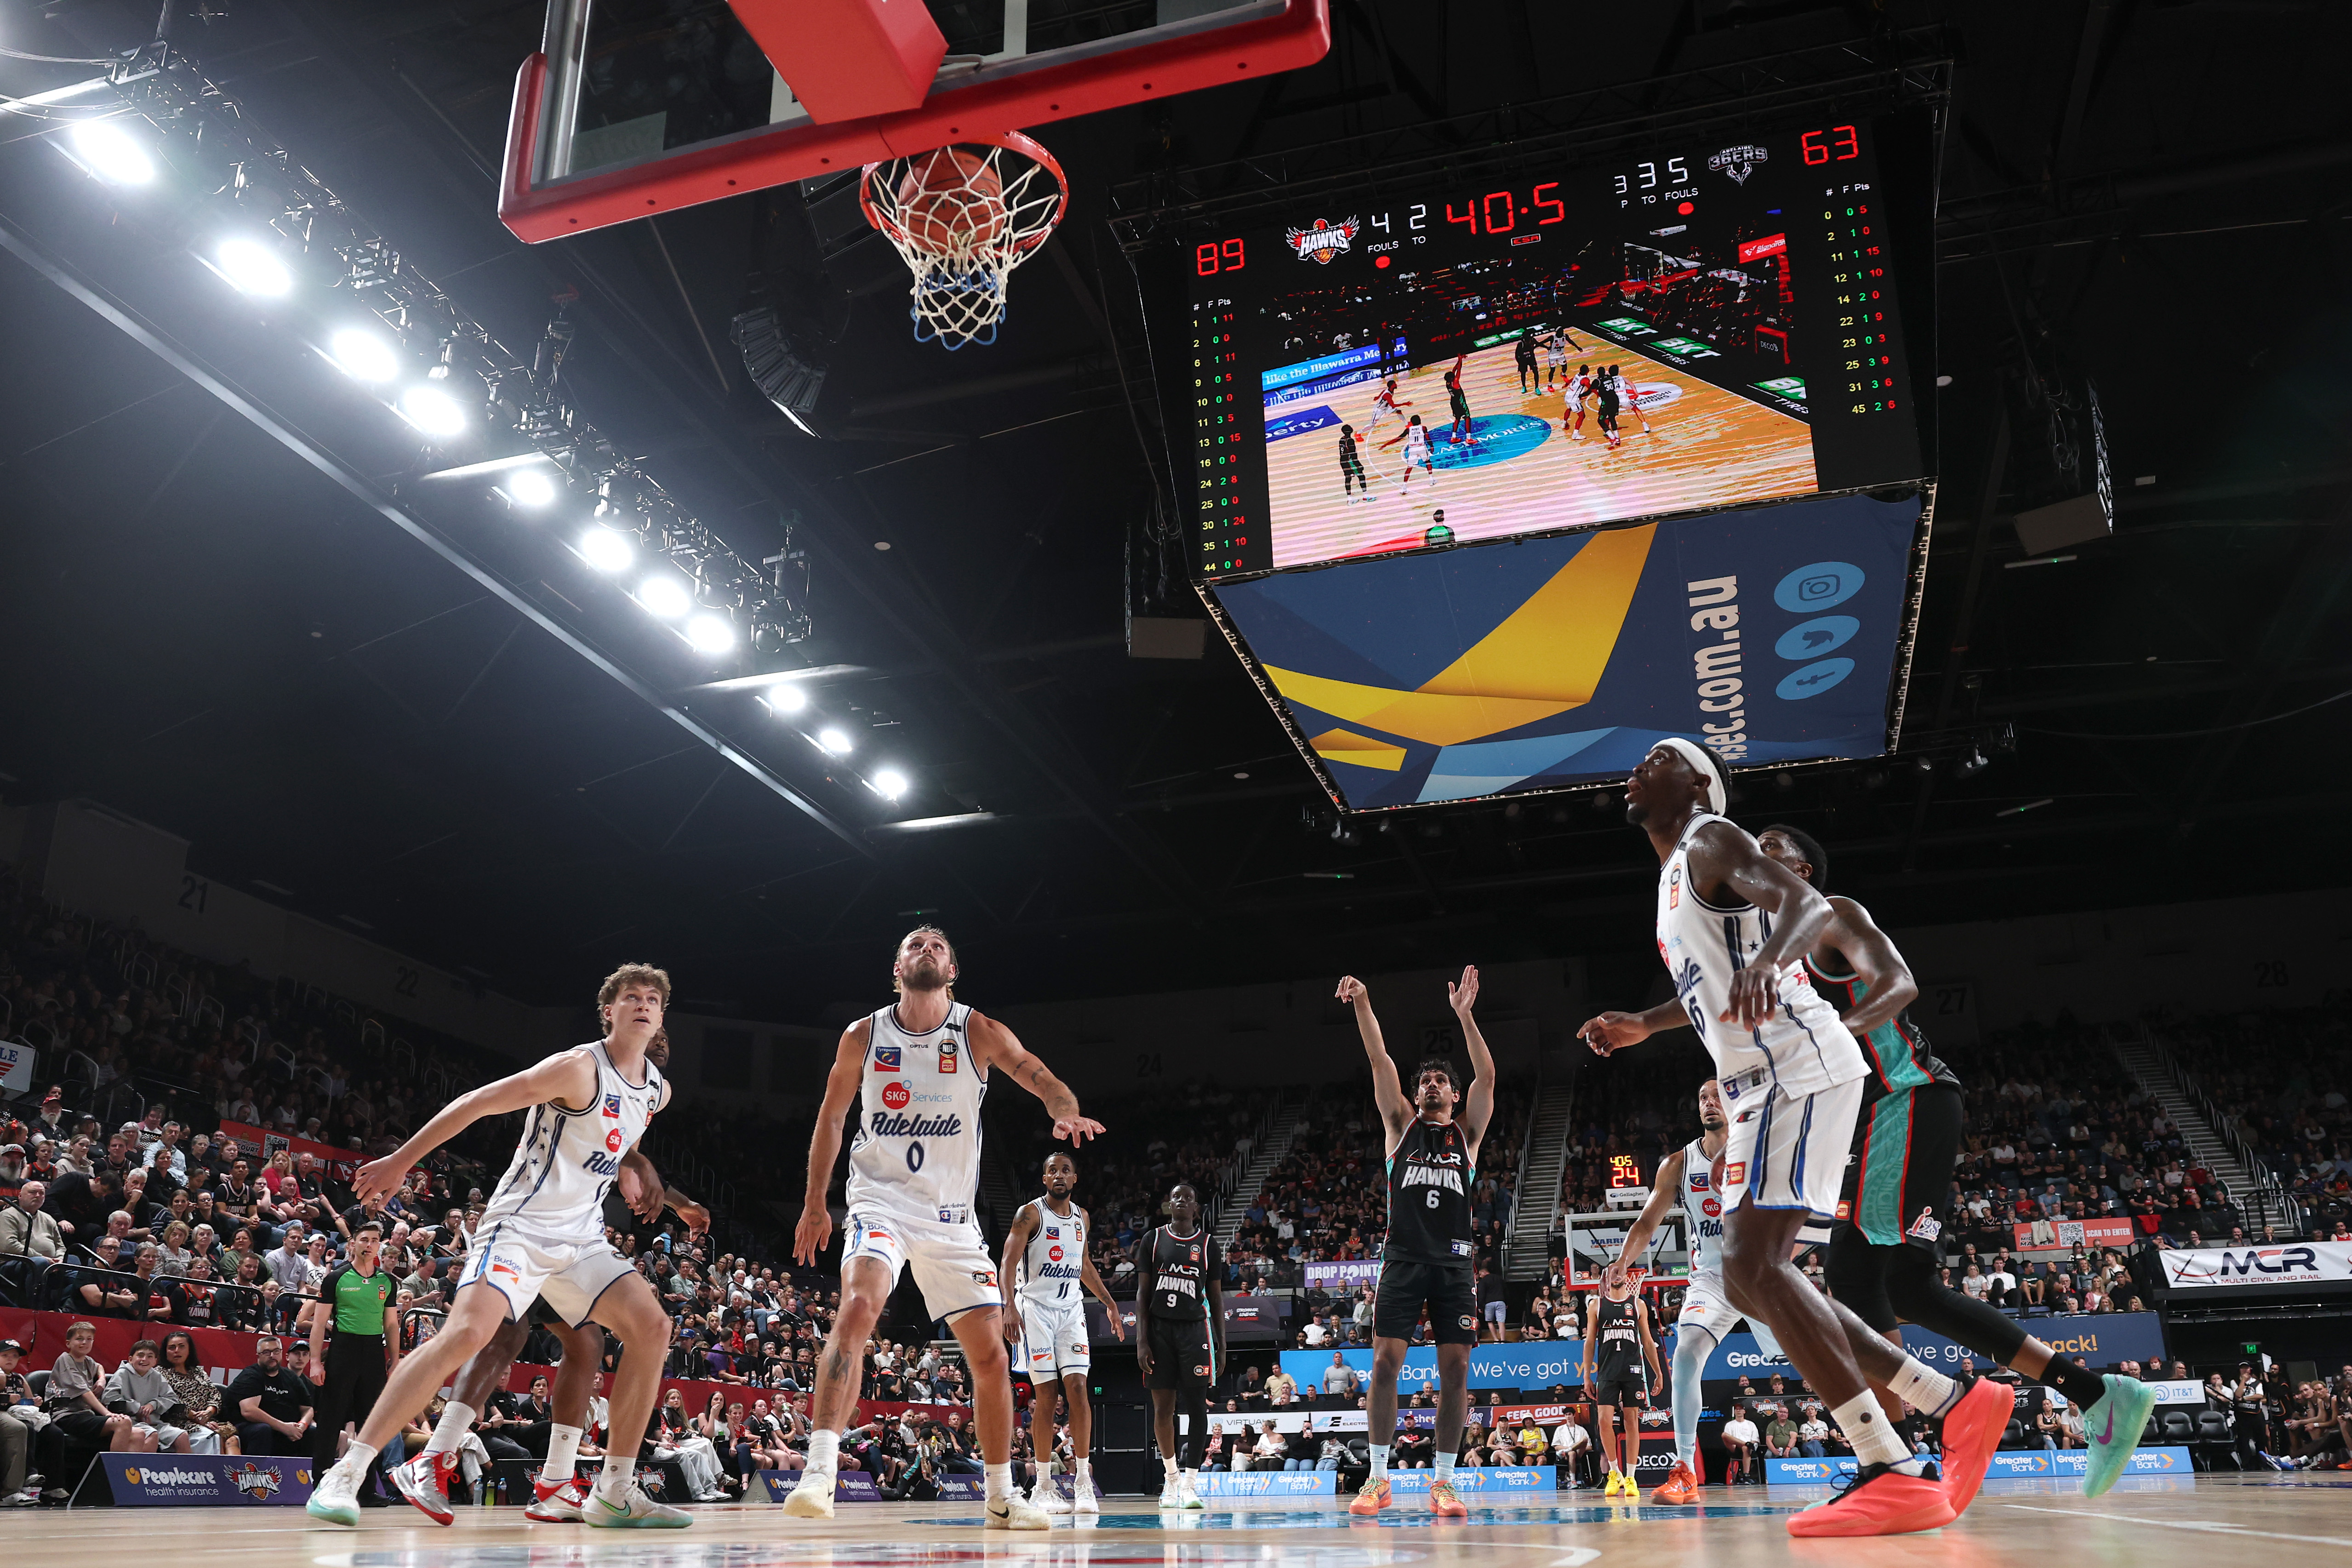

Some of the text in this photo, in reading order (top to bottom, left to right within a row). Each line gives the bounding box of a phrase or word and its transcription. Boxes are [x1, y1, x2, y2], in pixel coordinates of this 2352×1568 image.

[1801, 125, 1859, 165] 63
[1710, 148, 1767, 168] 36ERS
[1615, 157, 1688, 194] 3 3 5
[1641, 195, 1656, 204] TO
[1665, 188, 1698, 200] FOULS
[1372, 204, 1426, 233] 4 2
[1300, 230, 1348, 256] HAWKS
[1368, 236, 1426, 253] FOULS TO
[1197, 238, 1245, 276] 89
[1832, 252, 1843, 261] 11
[1867, 246, 1879, 255] 15
[1834, 274, 1847, 282] 12
[1870, 268, 1883, 277] 10
[1658, 338, 1723, 359] BKT
[1266, 374, 1281, 385] like
[1286, 367, 1308, 380] the
[1310, 354, 1362, 375] Illawarra
[1852, 400, 1895, 413] 45 2 6
[1199, 439, 1210, 447] 13
[1230, 433, 1241, 442] 15
[1200, 479, 1212, 488] 24
[1203, 521, 1214, 530] 30
[1233, 516, 1245, 525] 24
[1204, 542, 1215, 551] 35
[1235, 537, 1247, 546] 10
[177, 875, 208, 913] 21
[2254, 961, 2289, 988] 28
[1937, 987, 1968, 1015] 27
[942, 1044, 954, 1053] NBL
[885, 1091, 952, 1102] SKG Services
[871, 1111, 961, 1137] Adelaide
[906, 1140, 925, 1174] 0
[1426, 1152, 1462, 1165] MCR
[1401, 1165, 1465, 1197] HAWKS
[1611, 1167, 1639, 1187] 24
[1426, 1190, 1440, 1209] 6
[2086, 1229, 2102, 1237] SCAN
[2112, 1227, 2131, 1236] ENTER
[493, 1254, 523, 1275] Budget
[2221, 1248, 2319, 1276] MCR
[1169, 1263, 1199, 1277] MCR
[1307, 1264, 1378, 1282] DROP POINT
[1056, 1282, 1070, 1300] 11
[1167, 1294, 1177, 1307] 9
[1613, 1319, 1635, 1327] MCR
[1603, 1329, 1636, 1344] HAWKS
[1031, 1346, 1051, 1356] Budget
[1616, 1341, 1621, 1351] 1
[1472, 1361, 1530, 1379] We've
[1537, 1359, 1569, 1381] got
[2173, 1388, 2193, 1396] IT&T
[1506, 1406, 1565, 1420] FEEL GOOD
[1642, 1412, 1669, 1422] HAWKS
[1781, 1463, 1816, 1471] Greater
[1995, 1456, 2032, 1466] Greater
[2012, 1463, 2035, 1472] Bank
[2137, 1460, 2161, 1469] Bank
[139, 1467, 216, 1487] Peoplecare
[1228, 1477, 1258, 1485] Greater
[1279, 1476, 1309, 1484] Greater
[1495, 1471, 1529, 1480] Greater
[1796, 1470, 1819, 1478] Bank
[239, 1473, 276, 1490] HAWKS
[844, 1479, 872, 1490] Peoplecare
[1291, 1482, 1311, 1490] Bank
[1401, 1478, 1421, 1487] Bank
[1455, 1478, 1475, 1486] Bank
[1509, 1477, 1530, 1486] Bank
[145, 1486, 219, 1496] health insurance
